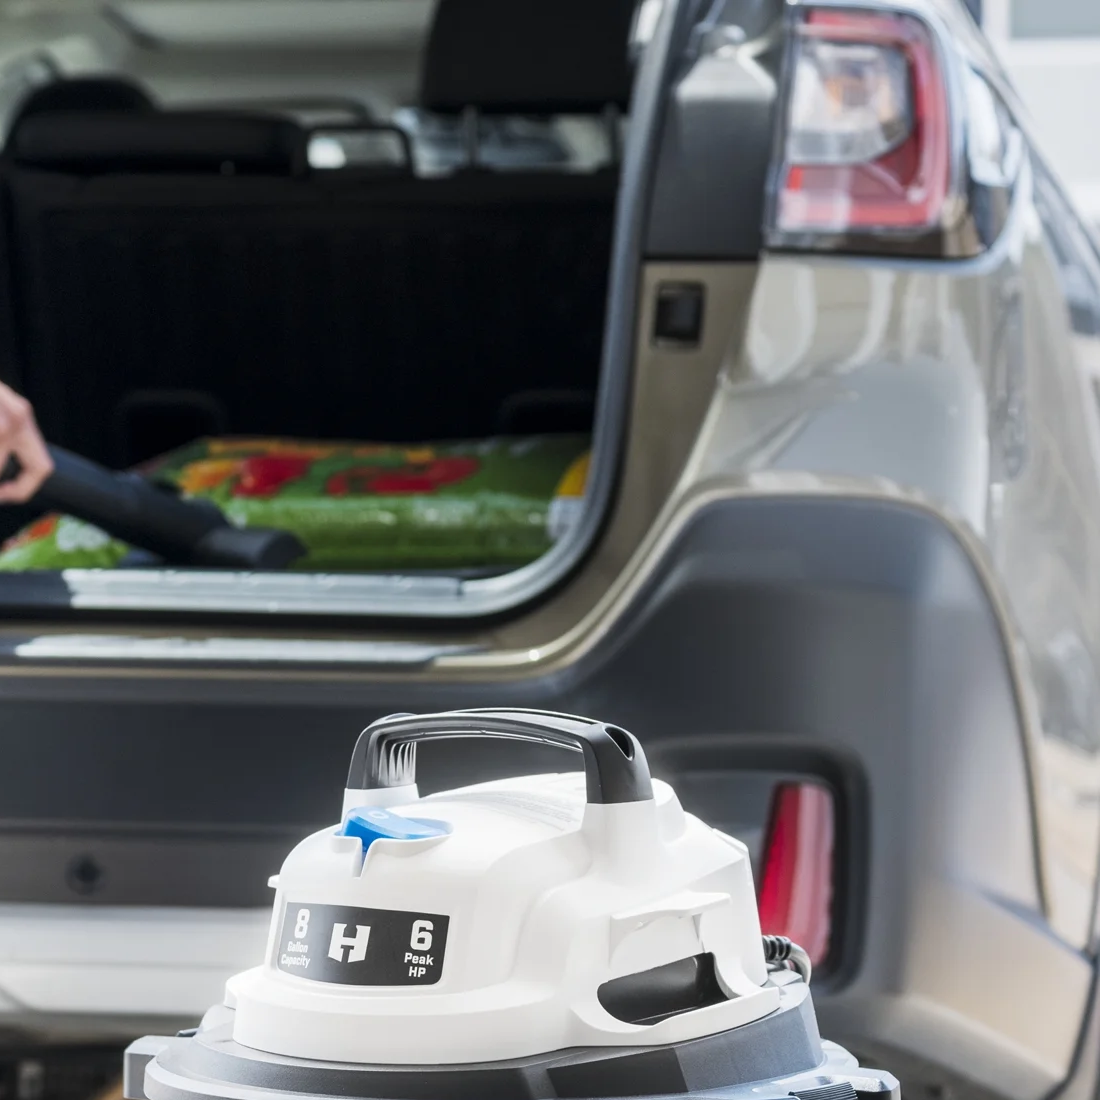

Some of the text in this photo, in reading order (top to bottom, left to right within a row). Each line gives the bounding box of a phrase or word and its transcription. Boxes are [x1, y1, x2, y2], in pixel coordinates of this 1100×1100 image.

[294, 909, 310, 939] 8
[328, 922, 371, 963] H
[410, 920, 434, 951] 6
[287, 941, 308, 954] Gallon
[281, 953, 311, 969] Capacity
[404, 953, 434, 966] Peak
[408, 966, 426, 978] HP
